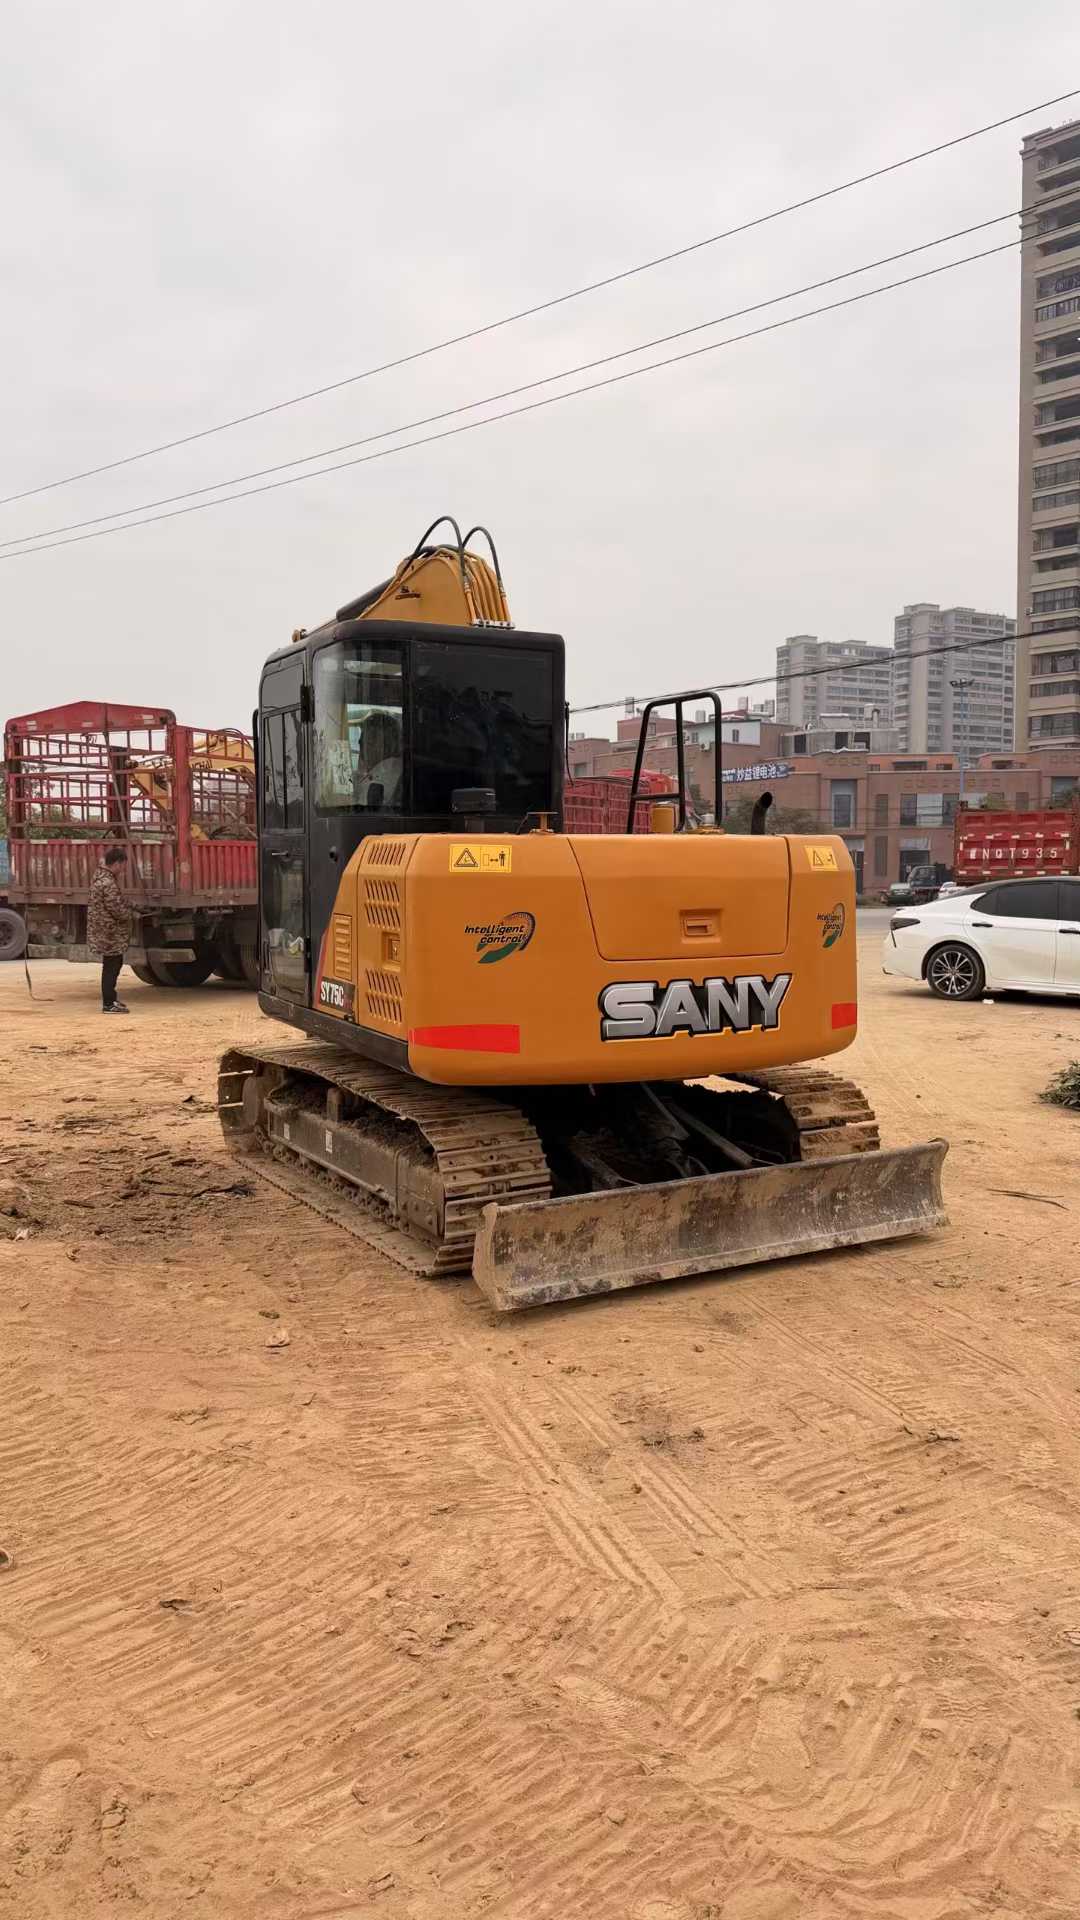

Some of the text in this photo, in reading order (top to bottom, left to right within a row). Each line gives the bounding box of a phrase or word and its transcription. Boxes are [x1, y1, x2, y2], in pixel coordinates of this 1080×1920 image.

[464, 923, 525, 936] Intelligent
[480, 934, 523, 944] control
[320, 980, 344, 1008] SY75C
[598, 973, 793, 1042] SANY
